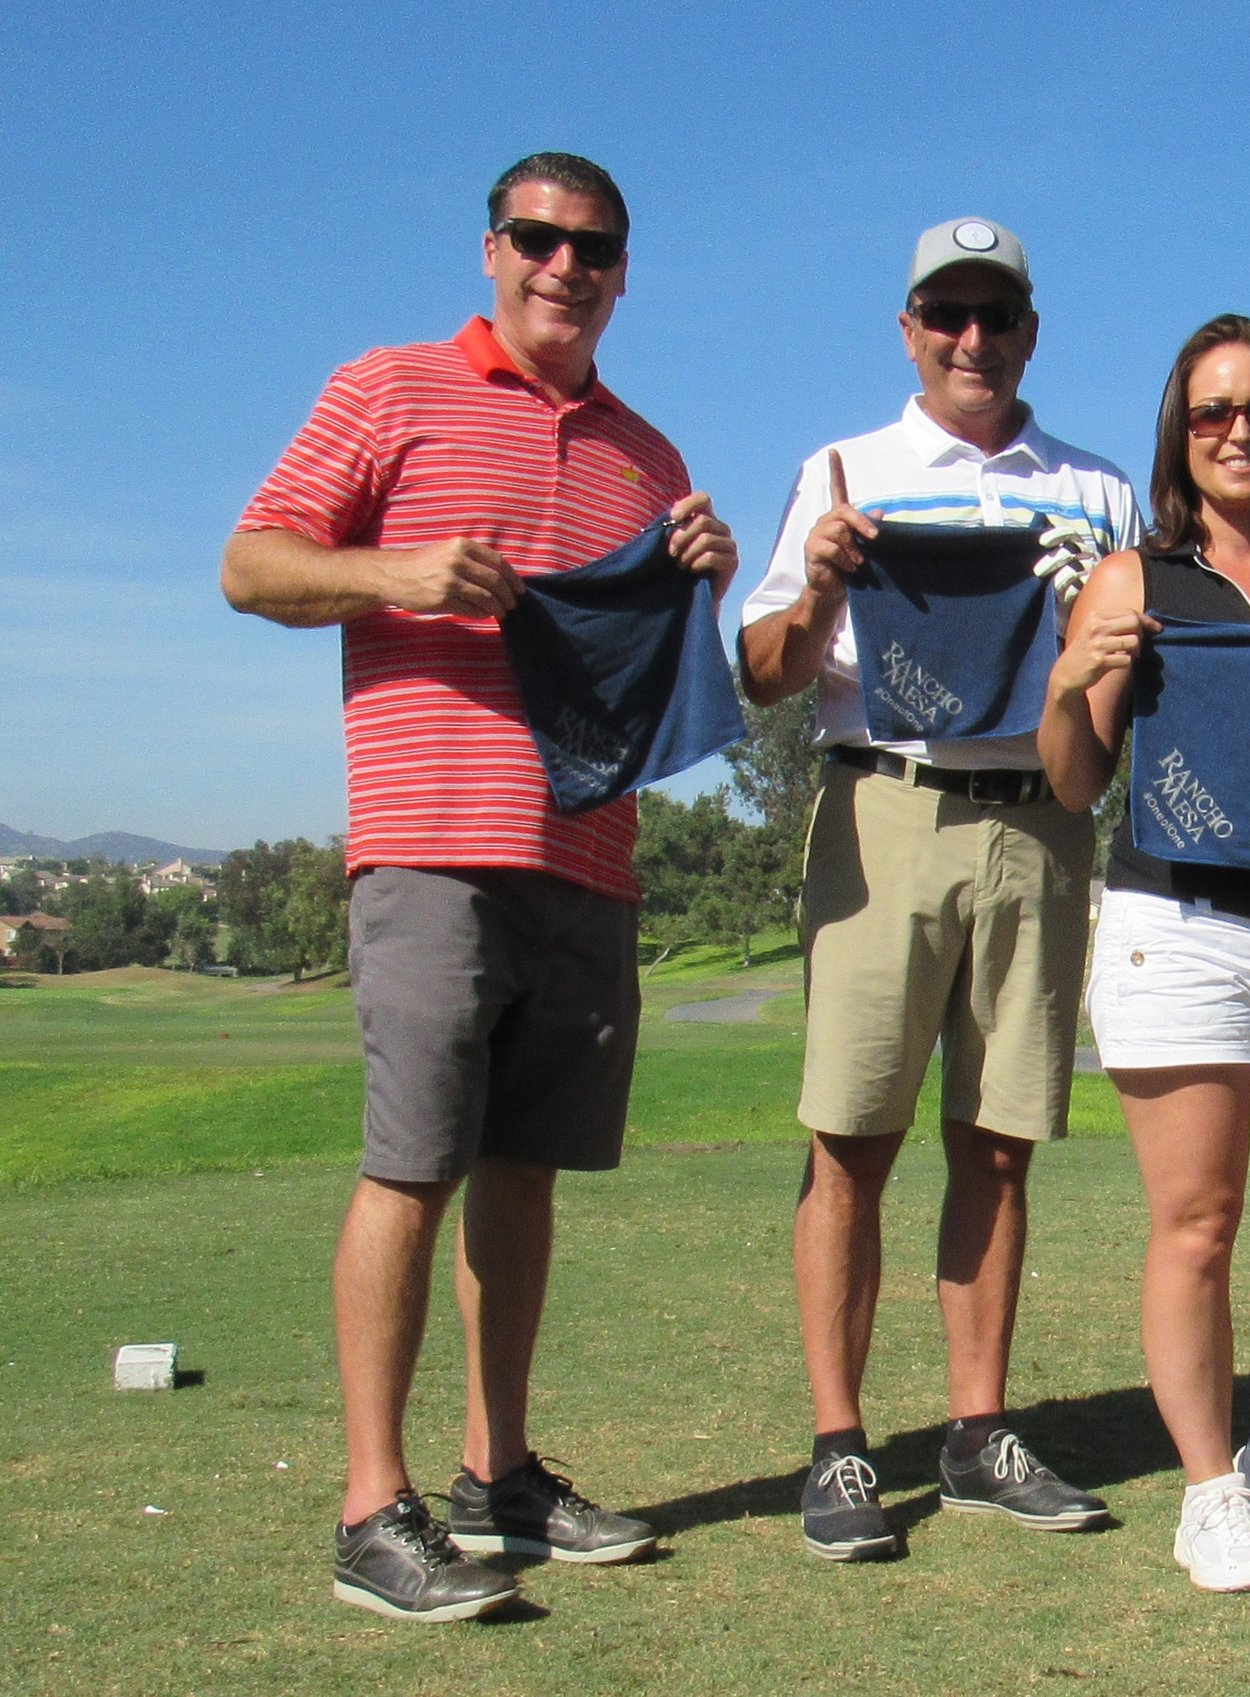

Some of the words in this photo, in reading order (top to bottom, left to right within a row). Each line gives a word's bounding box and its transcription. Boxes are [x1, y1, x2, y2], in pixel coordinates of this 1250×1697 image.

[881, 640, 964, 716] RANCHO
[883, 660, 939, 724] MESA
[1142, 791, 1186, 850] #OneofOne
[1152, 774, 1206, 845] MESA
[1157, 748, 1234, 840] RANCHO
